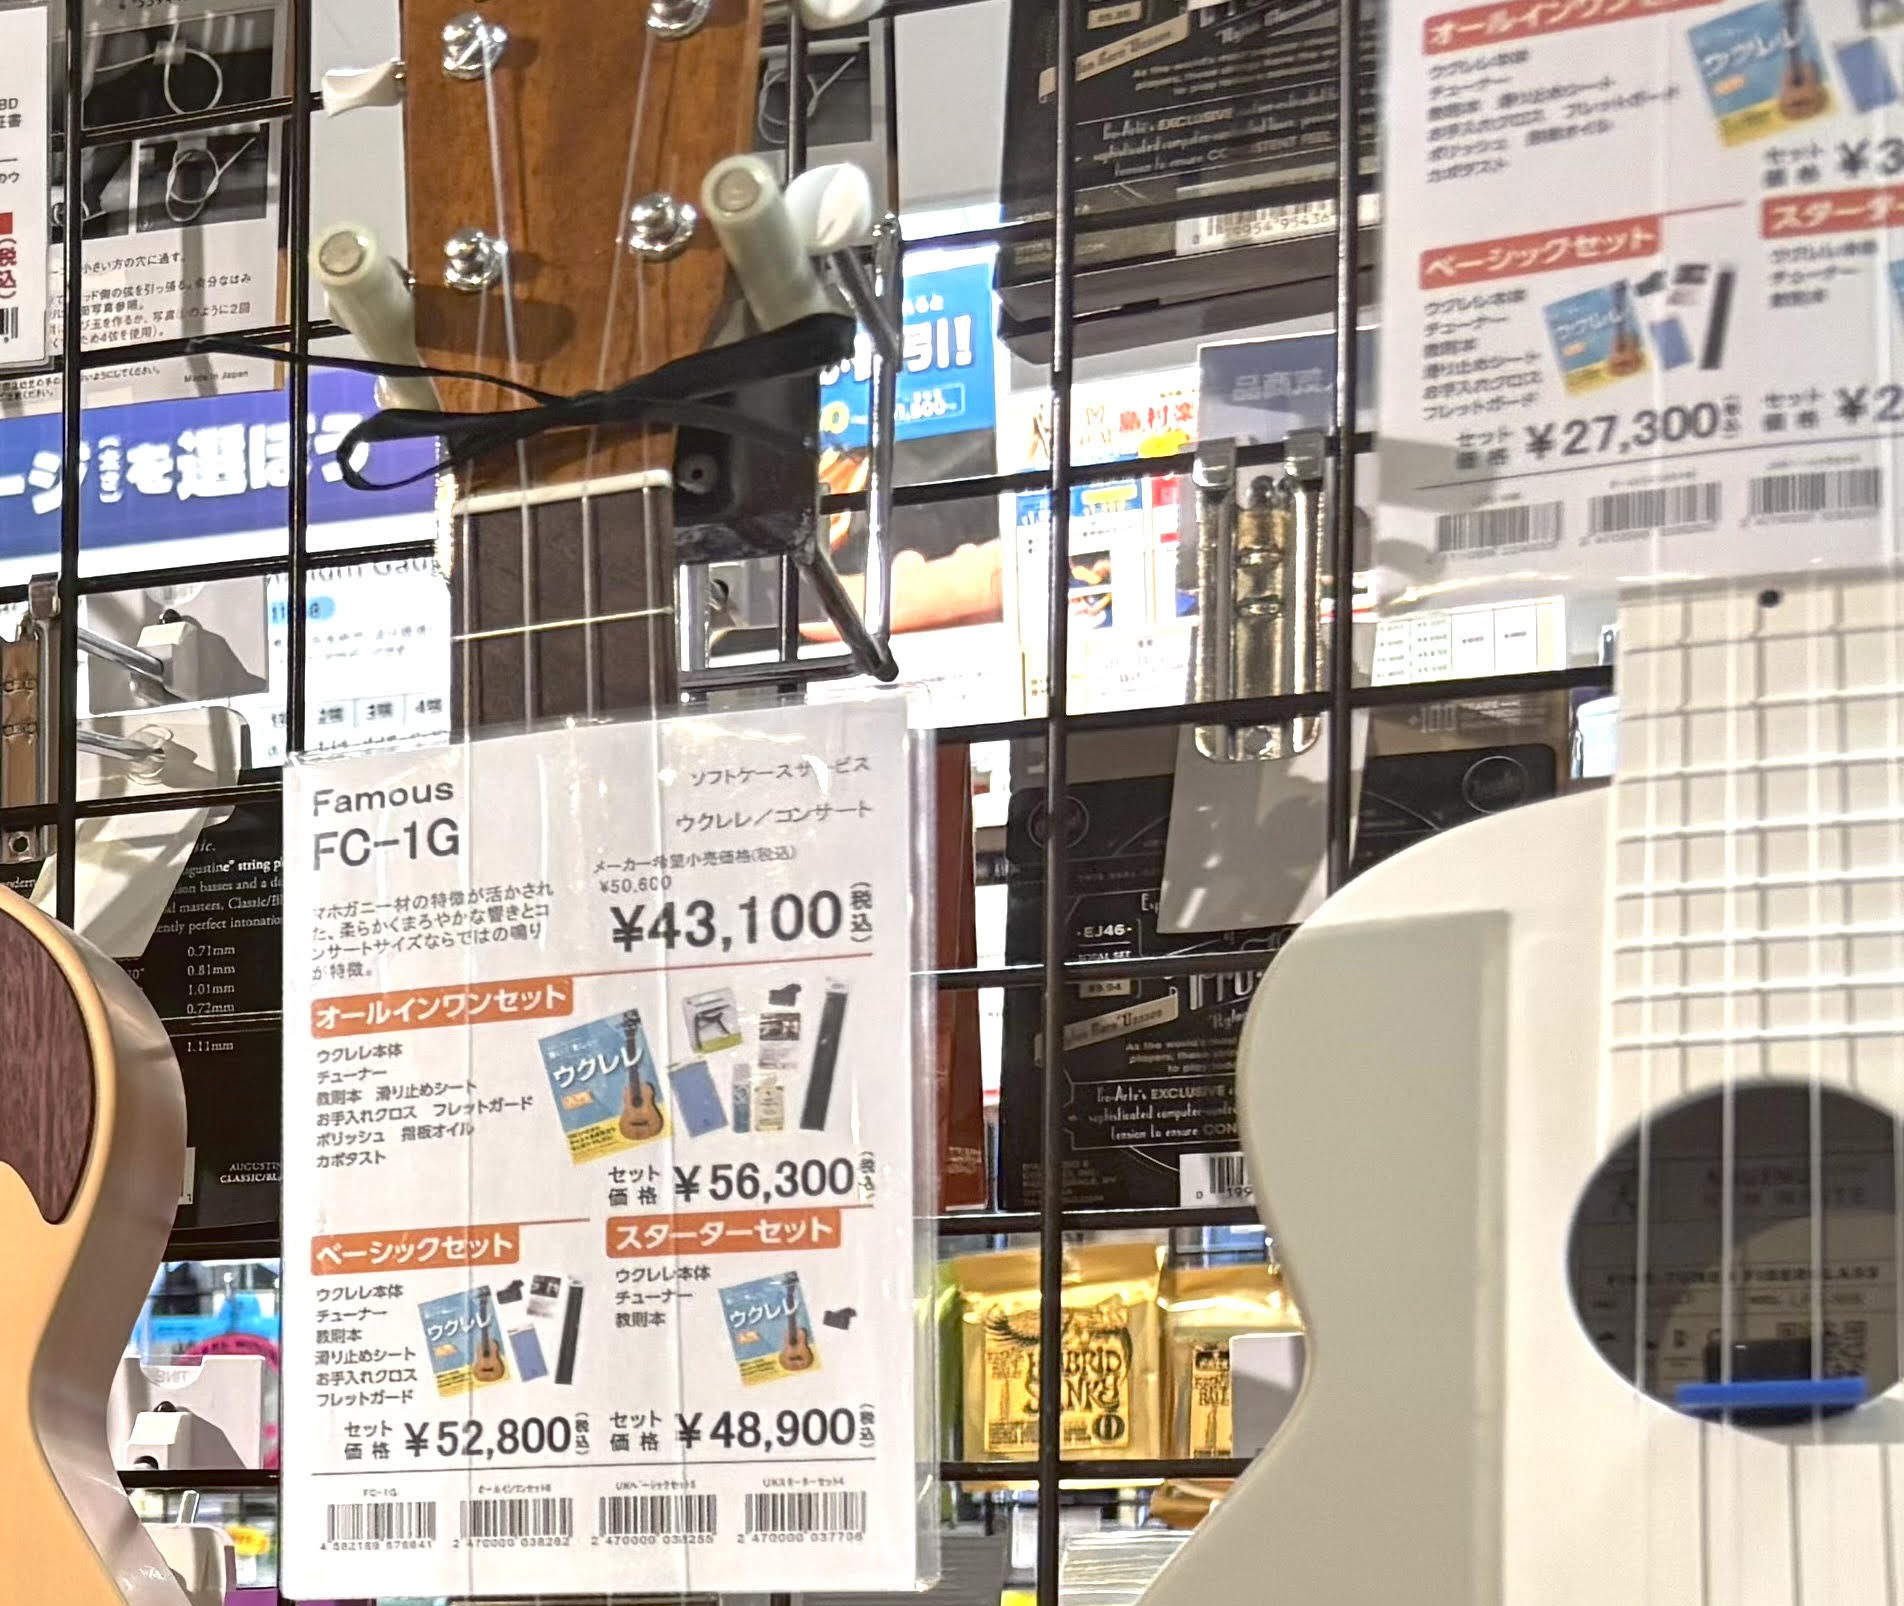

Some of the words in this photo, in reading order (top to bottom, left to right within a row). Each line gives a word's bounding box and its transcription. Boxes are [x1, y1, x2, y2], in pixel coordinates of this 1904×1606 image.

[1427, 227, 1656, 275] ベーシックセット
[1525, 402, 1721, 459] ¥27,300
[311, 779, 455, 817] Famous
[674, 801, 873, 833] ウクレレ／コンサート
[311, 817, 461, 871] FC-1G
[238, 859, 270, 872] string
[236, 877, 257, 890] and
[261, 879, 267, 888] a
[611, 890, 842, 953] ¥43,100
[850, 880, 873, 944] (税込)
[188, 918, 227, 934] perfect
[187, 945, 235, 957] 0.71mm
[187, 964, 235, 976] 0.81mm
[188, 983, 235, 995] 1.01mm
[316, 982, 567, 1030] オールインワンセット
[187, 1040, 234, 1053] 1.11mm
[316, 1043, 403, 1065] ウクレレ本体
[316, 1067, 387, 1085] チューナー
[551, 1044, 645, 1091] ウクレレ
[376, 1078, 478, 1103] 滑り止めシート
[316, 1105, 417, 1128] お手入れクロス
[432, 1094, 534, 1118] フレットガード
[316, 1128, 385, 1147] ポリッシュ
[316, 1150, 387, 1170] カポタスト
[673, 1158, 855, 1204] ¥56,300
[616, 1219, 834, 1252] スターターセット
[316, 1232, 513, 1266] ベーシックセット
[615, 1264, 713, 1285] ウクレレ本体
[316, 1283, 404, 1303] ウクレレ本体
[615, 1289, 693, 1306] チューナー
[316, 1306, 388, 1324] チューナー
[314, 1346, 417, 1365] 滑り止めシート
[315, 1366, 418, 1385] お手入れクロス
[316, 1389, 415, 1408] フレットガード
[404, 1416, 571, 1460] ¥52,800
[678, 1409, 856, 1449] ¥48,900
